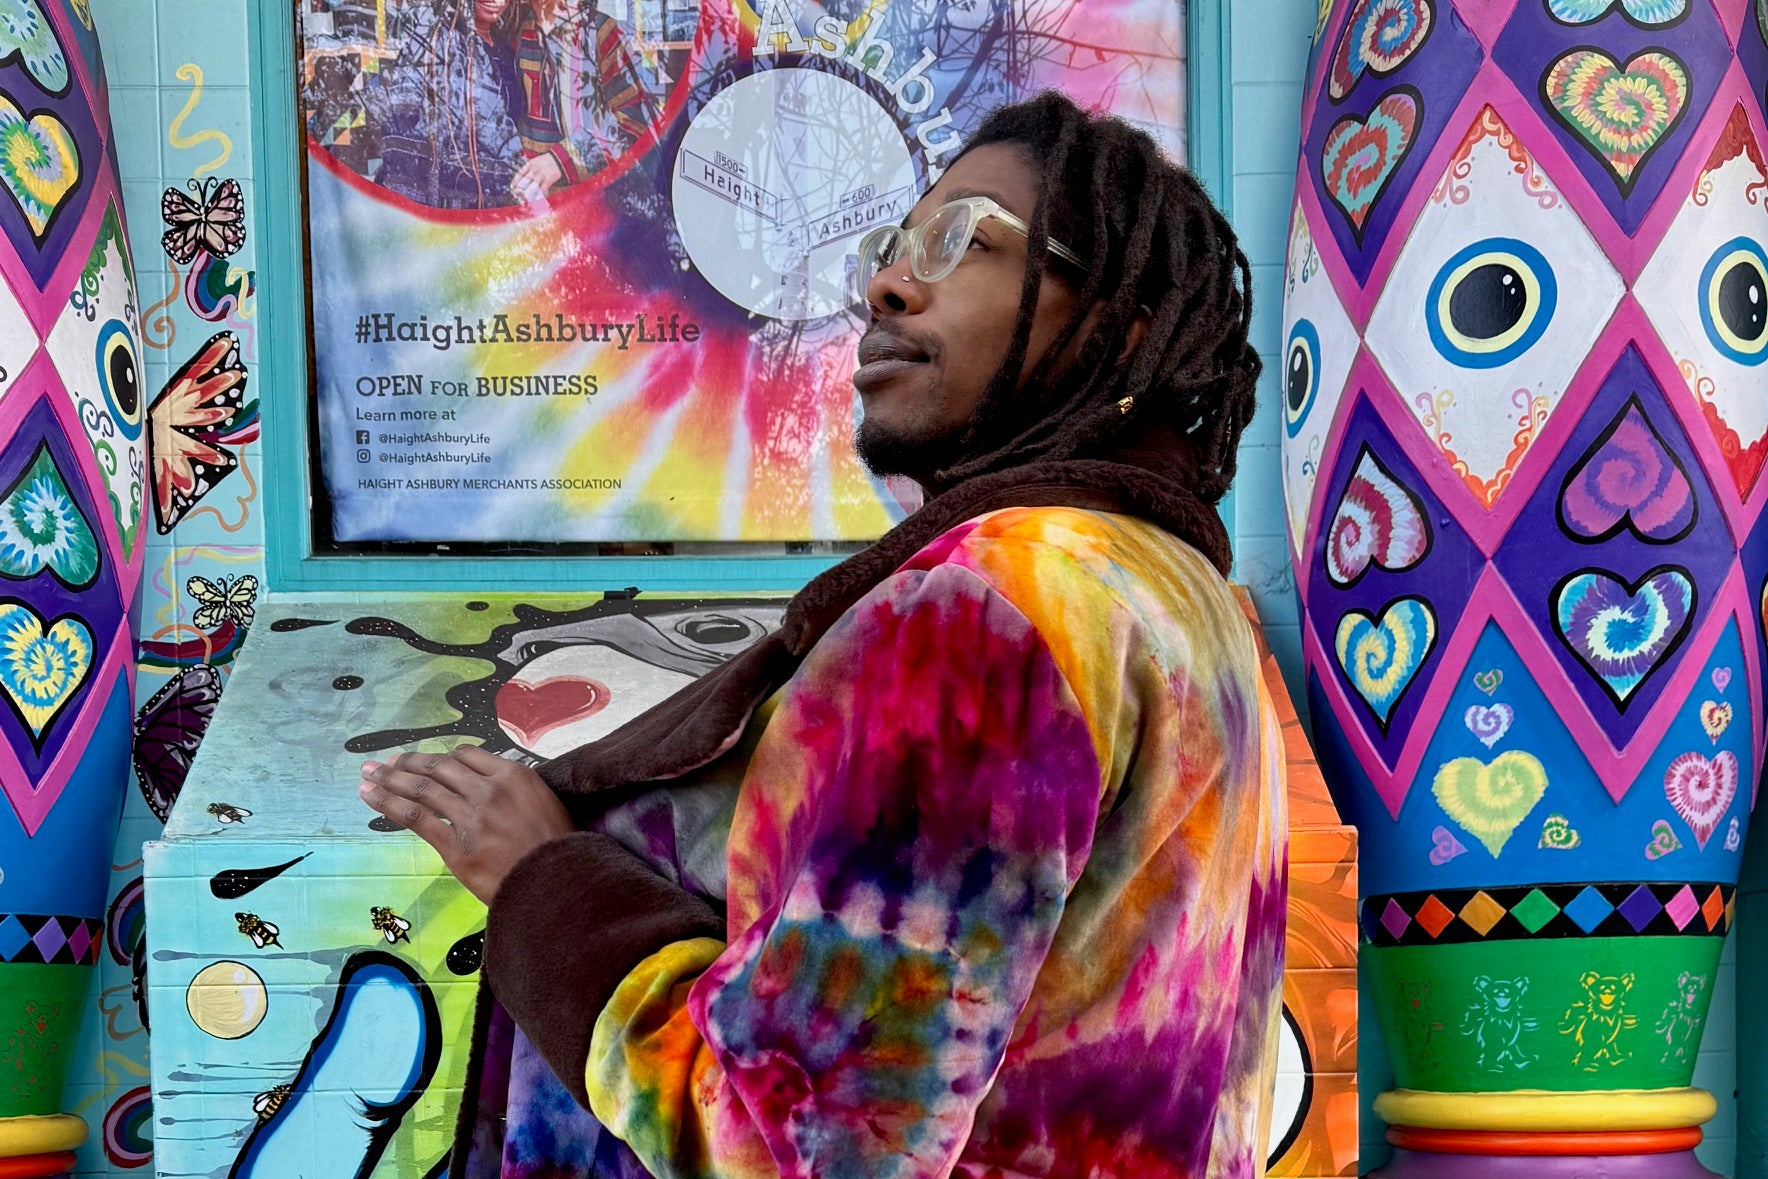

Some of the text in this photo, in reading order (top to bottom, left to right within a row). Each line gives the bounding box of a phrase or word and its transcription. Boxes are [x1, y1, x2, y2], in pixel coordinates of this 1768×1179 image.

[716, 153, 740, 173] 1500
[703, 164, 761, 207] Haight
[850, 187, 872, 202] 600
[818, 199, 898, 240] Ashbury
[354, 312, 701, 351] #HaightAshburyLife
[355, 375, 599, 398] OPEN FOR BUSINESS
[355, 407, 457, 422] Learn more at
[378, 433, 491, 446] @HaightAshburyLife
[378, 452, 492, 466] @HaightAshburyLife
[357, 479, 622, 490] HAIGHT ASHBURY MERCHANTS ASSOCIATION
